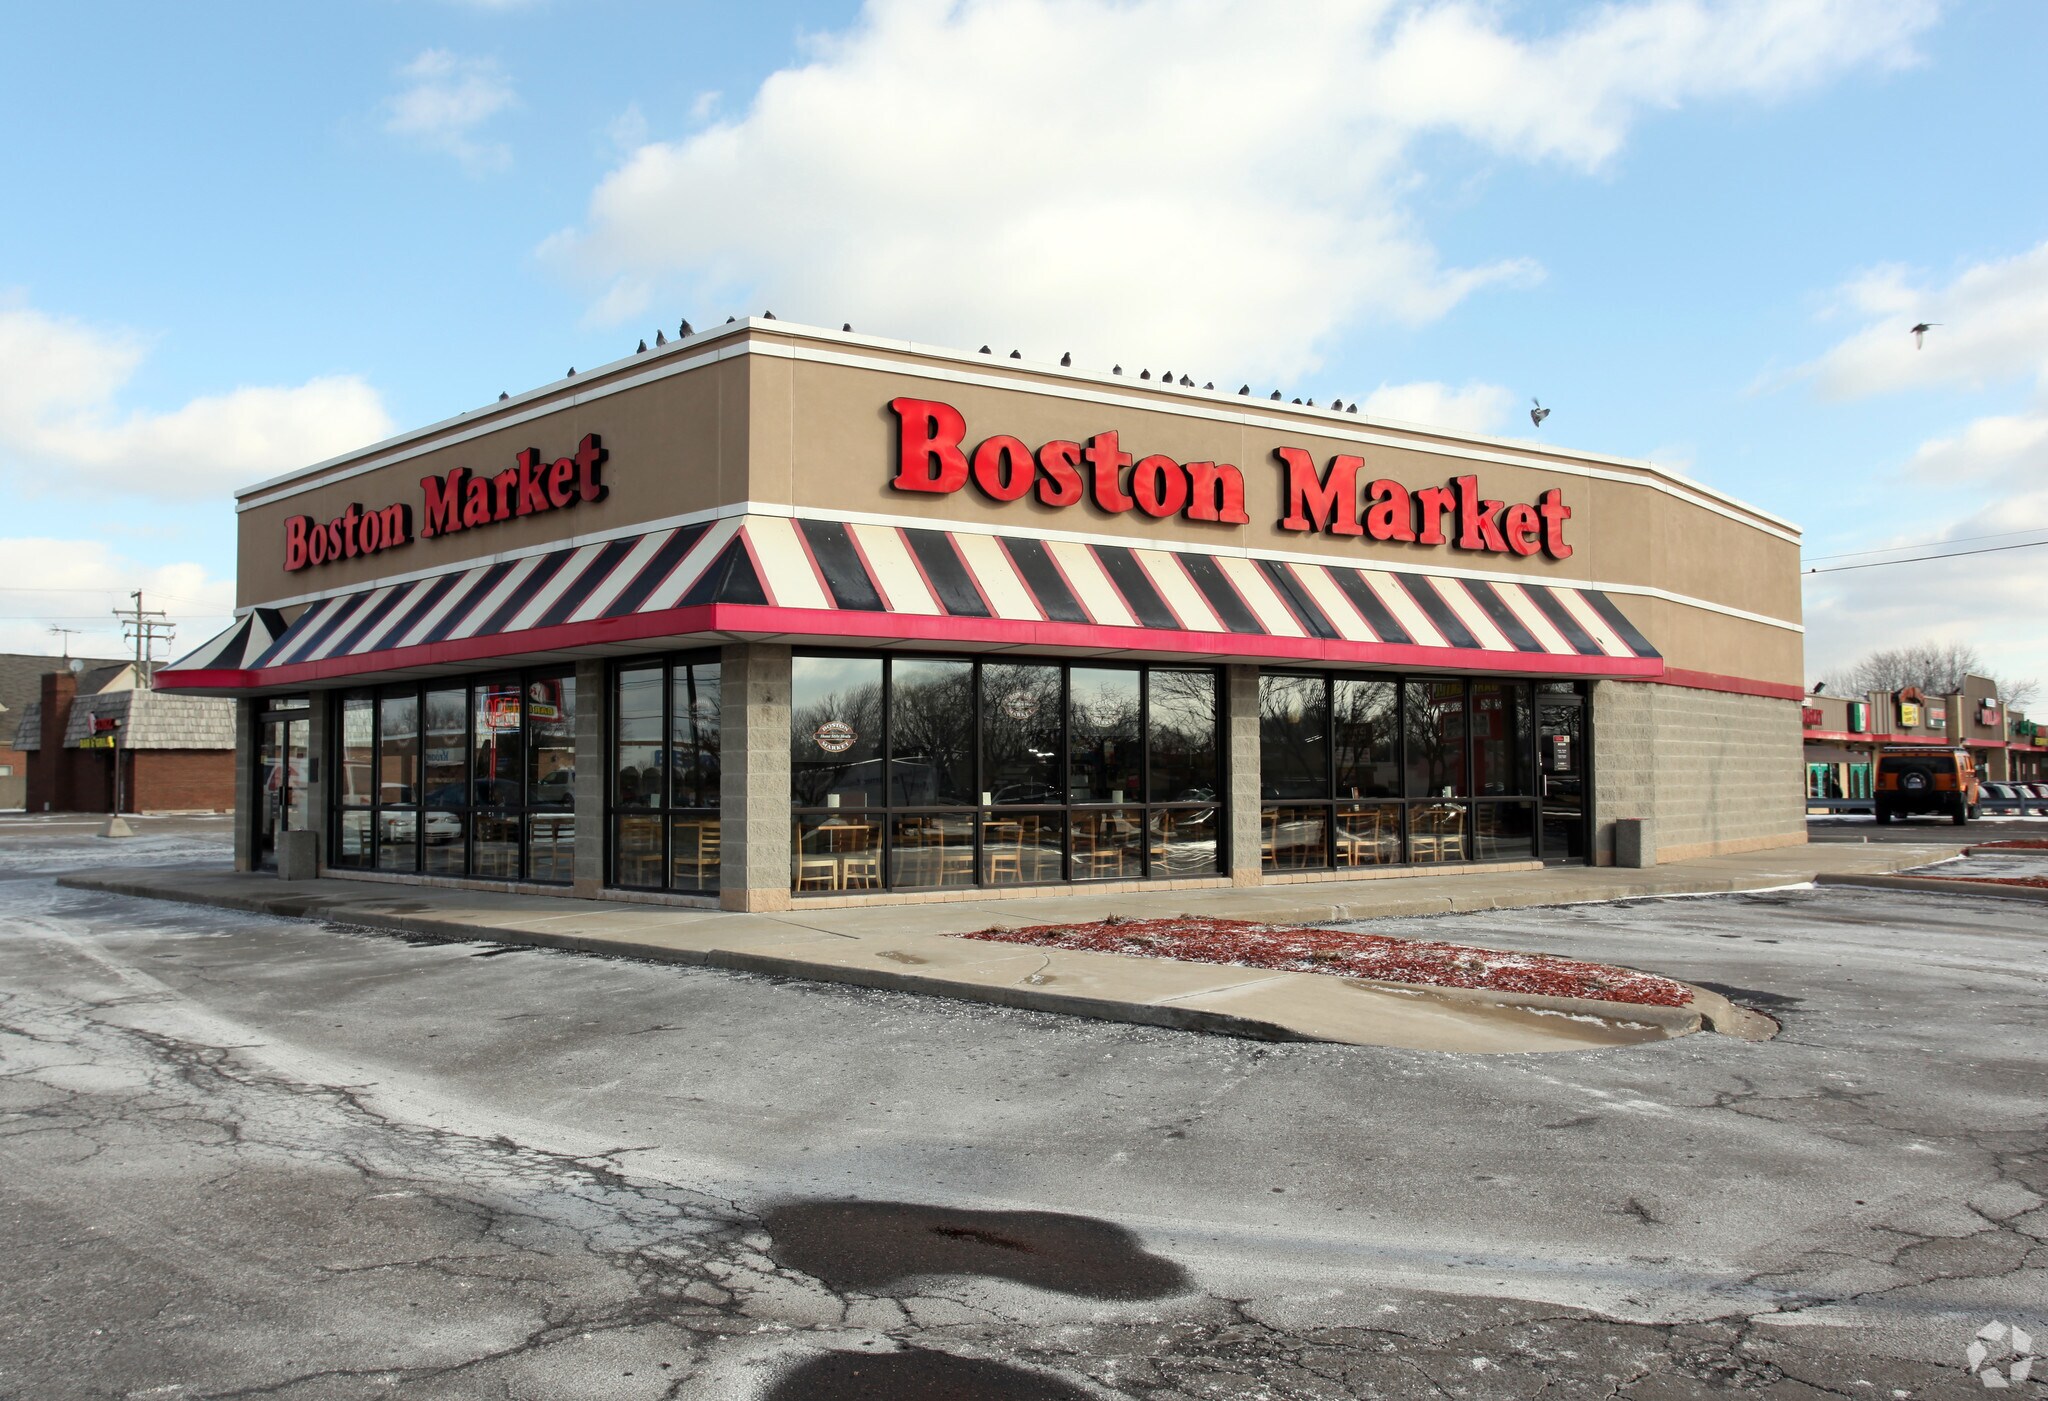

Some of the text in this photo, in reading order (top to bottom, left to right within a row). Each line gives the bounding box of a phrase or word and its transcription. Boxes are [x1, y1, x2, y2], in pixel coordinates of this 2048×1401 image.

[283, 432, 606, 572] Boston Market
[890, 397, 1574, 560] Boston Market
[821, 723, 849, 731] BOSTON
[821, 741, 849, 751] MARKET
